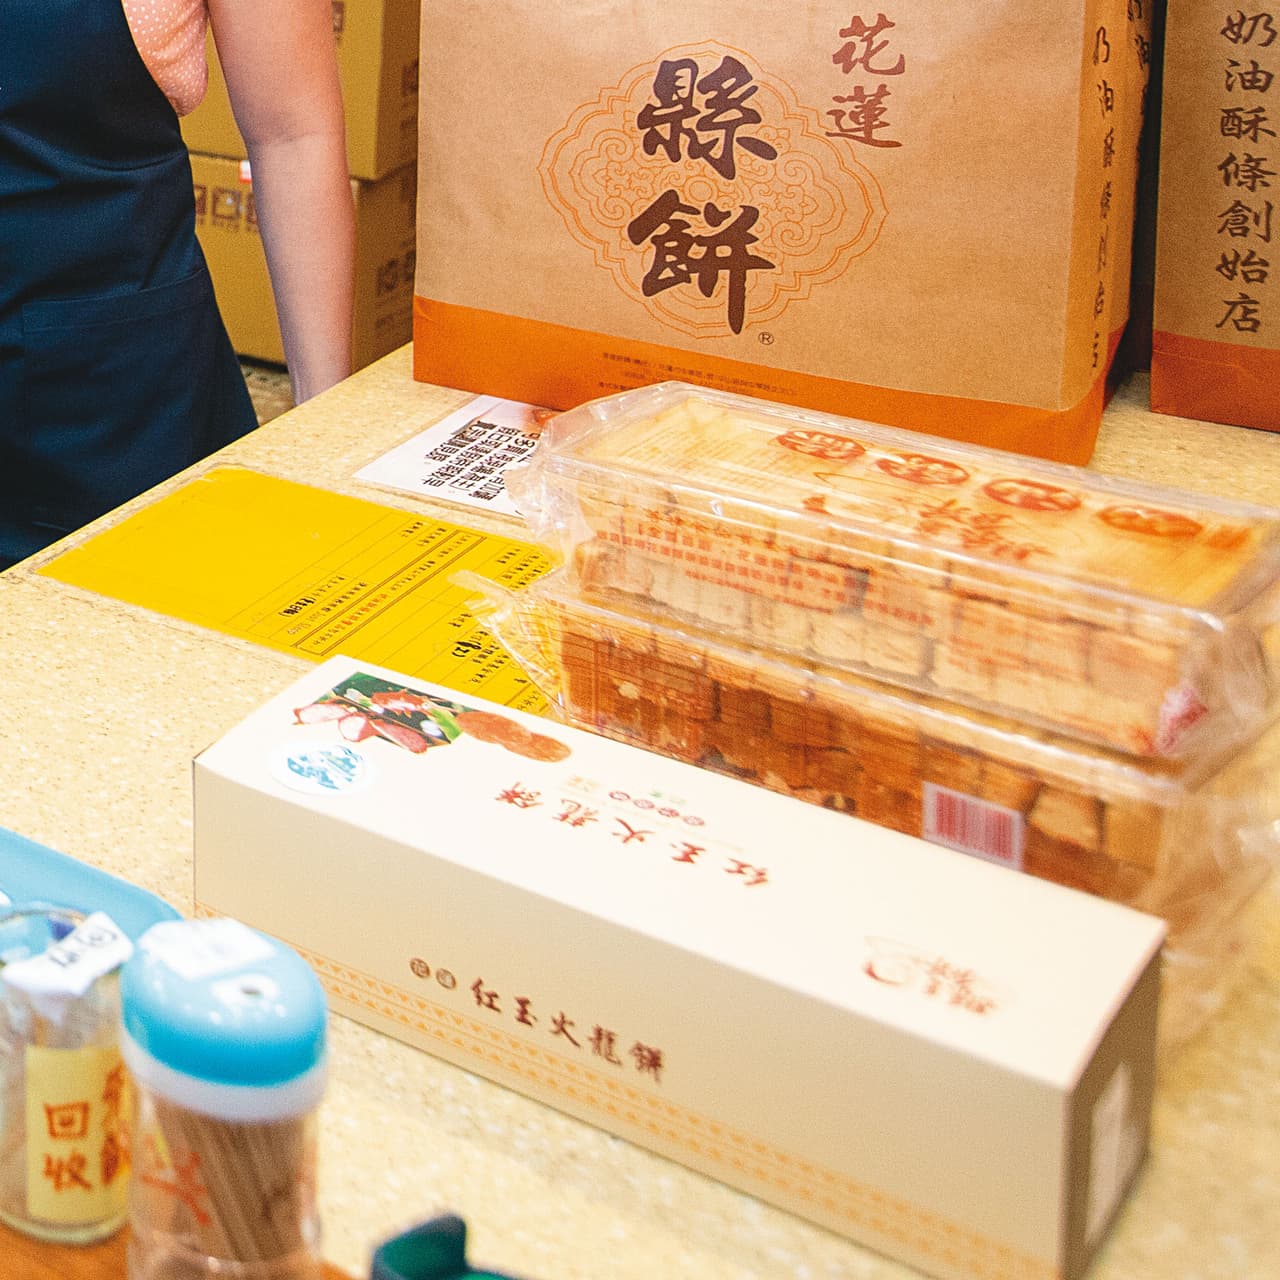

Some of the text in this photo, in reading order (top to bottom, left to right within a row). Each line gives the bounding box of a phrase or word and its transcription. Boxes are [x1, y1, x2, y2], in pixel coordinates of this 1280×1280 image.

[825, 12, 907, 149] 花蓮
[626, 56, 778, 333] 縣餅
[1215, 9, 1279, 334] 奶油酥條創始店
[470, 977, 666, 1084] 紅玉火龍餅
[43, 1100, 94, 1193] 回收
